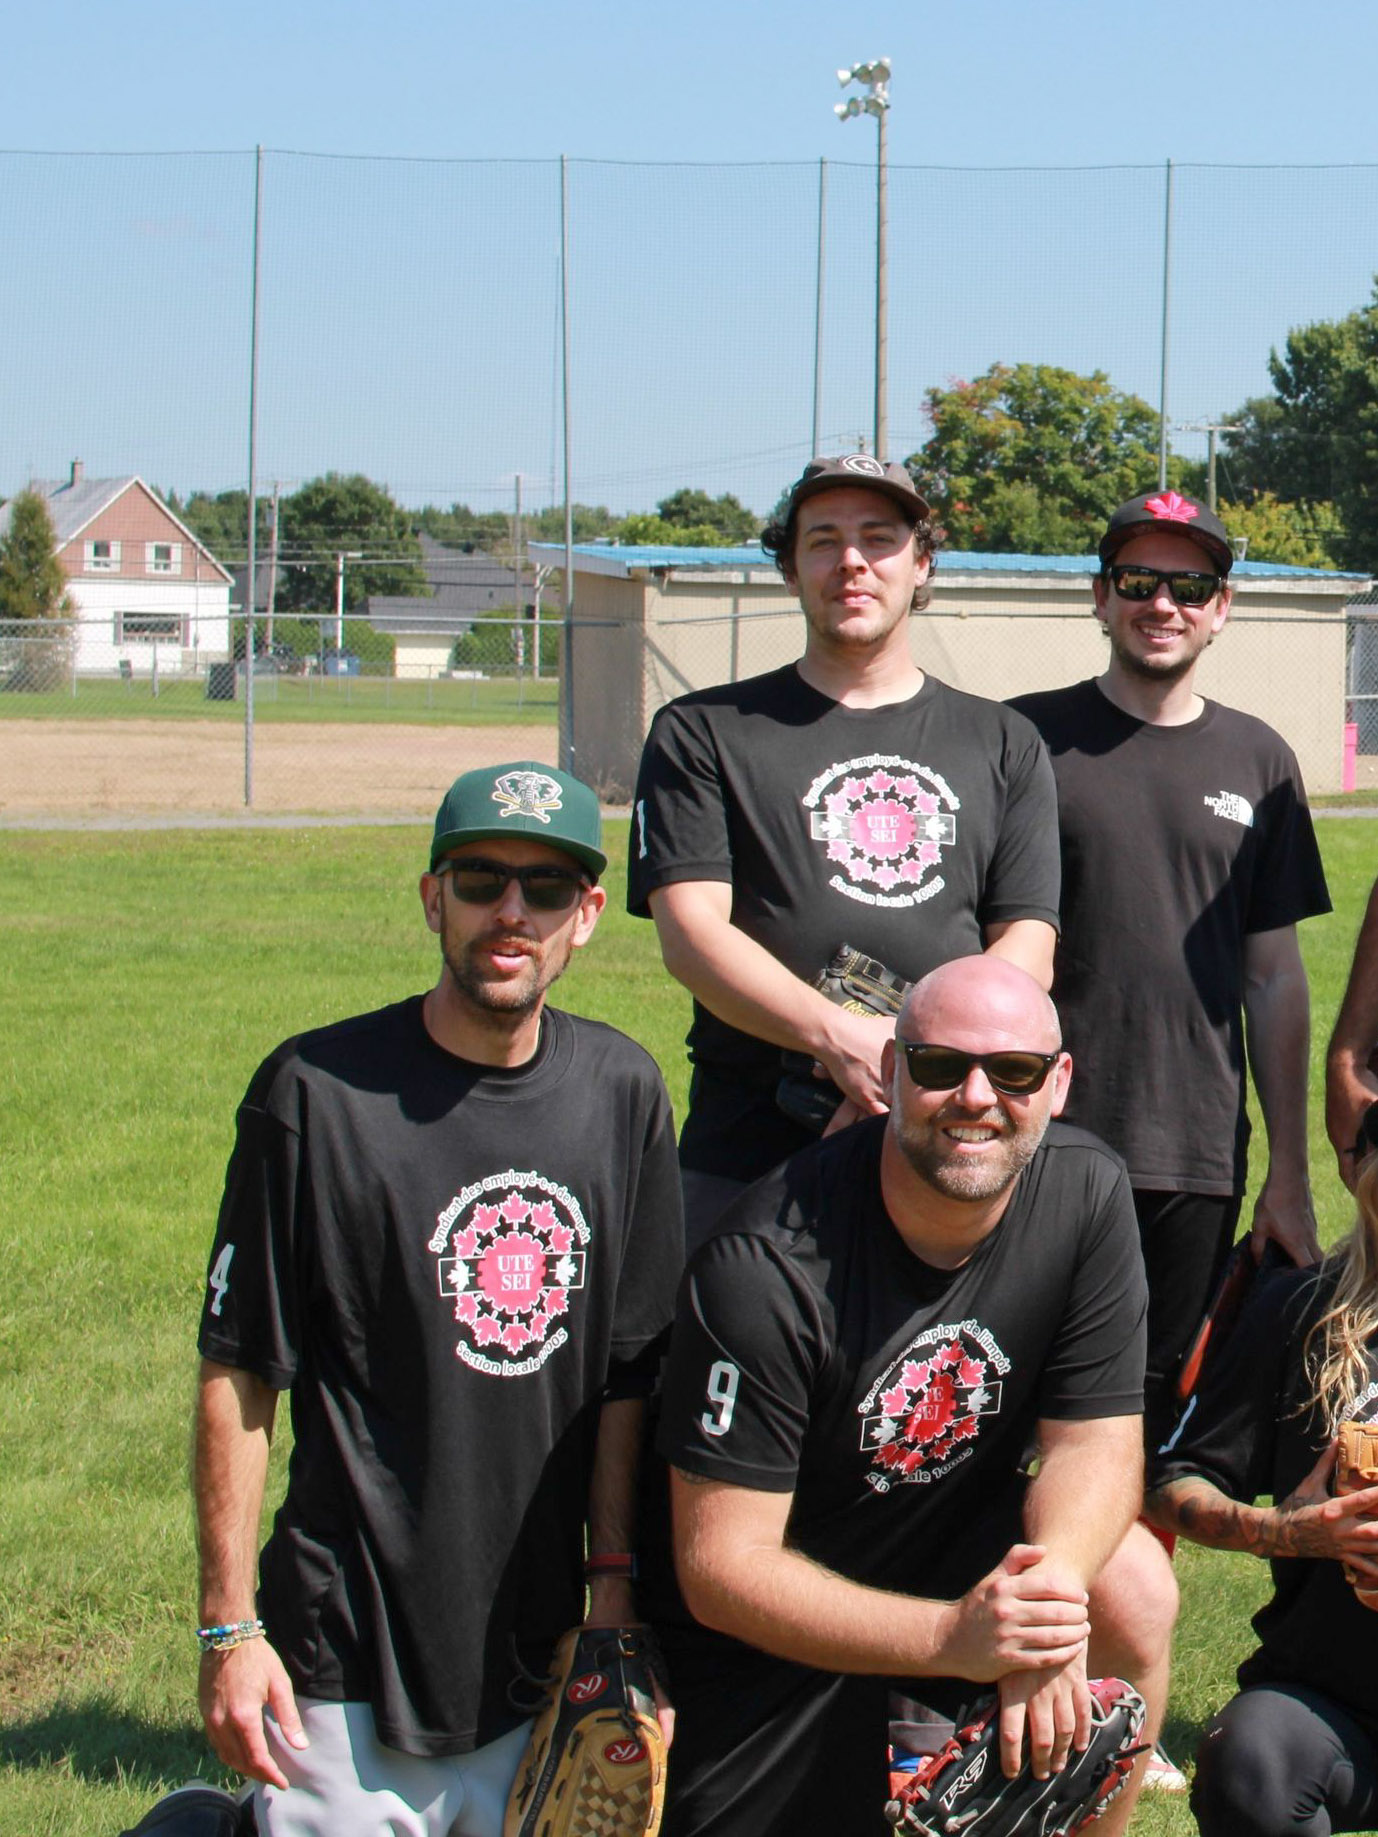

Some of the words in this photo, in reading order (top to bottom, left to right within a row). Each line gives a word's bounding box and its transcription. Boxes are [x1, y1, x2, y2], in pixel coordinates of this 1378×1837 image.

[1204, 795, 1239, 812] NORTH
[1219, 790, 1239, 803] THE
[866, 814, 899, 829] UTE
[1214, 805, 1239, 821] FACE
[870, 829, 897, 843] SEI
[829, 875, 875, 905] Section
[876, 893, 914, 908] locale
[912, 876, 945, 903] 10005
[428, 1197, 466, 1253] Syndicat
[461, 1182, 483, 1202] des
[556, 1186, 570, 1204] de
[497, 1255, 535, 1272] UTE
[209, 1243, 235, 1316] 4
[501, 1274, 531, 1291] SEI
[962, 1318, 980, 1338] de
[456, 1340, 501, 1376] Section
[501, 1357, 540, 1377] locale
[701, 1360, 740, 1436] 9
